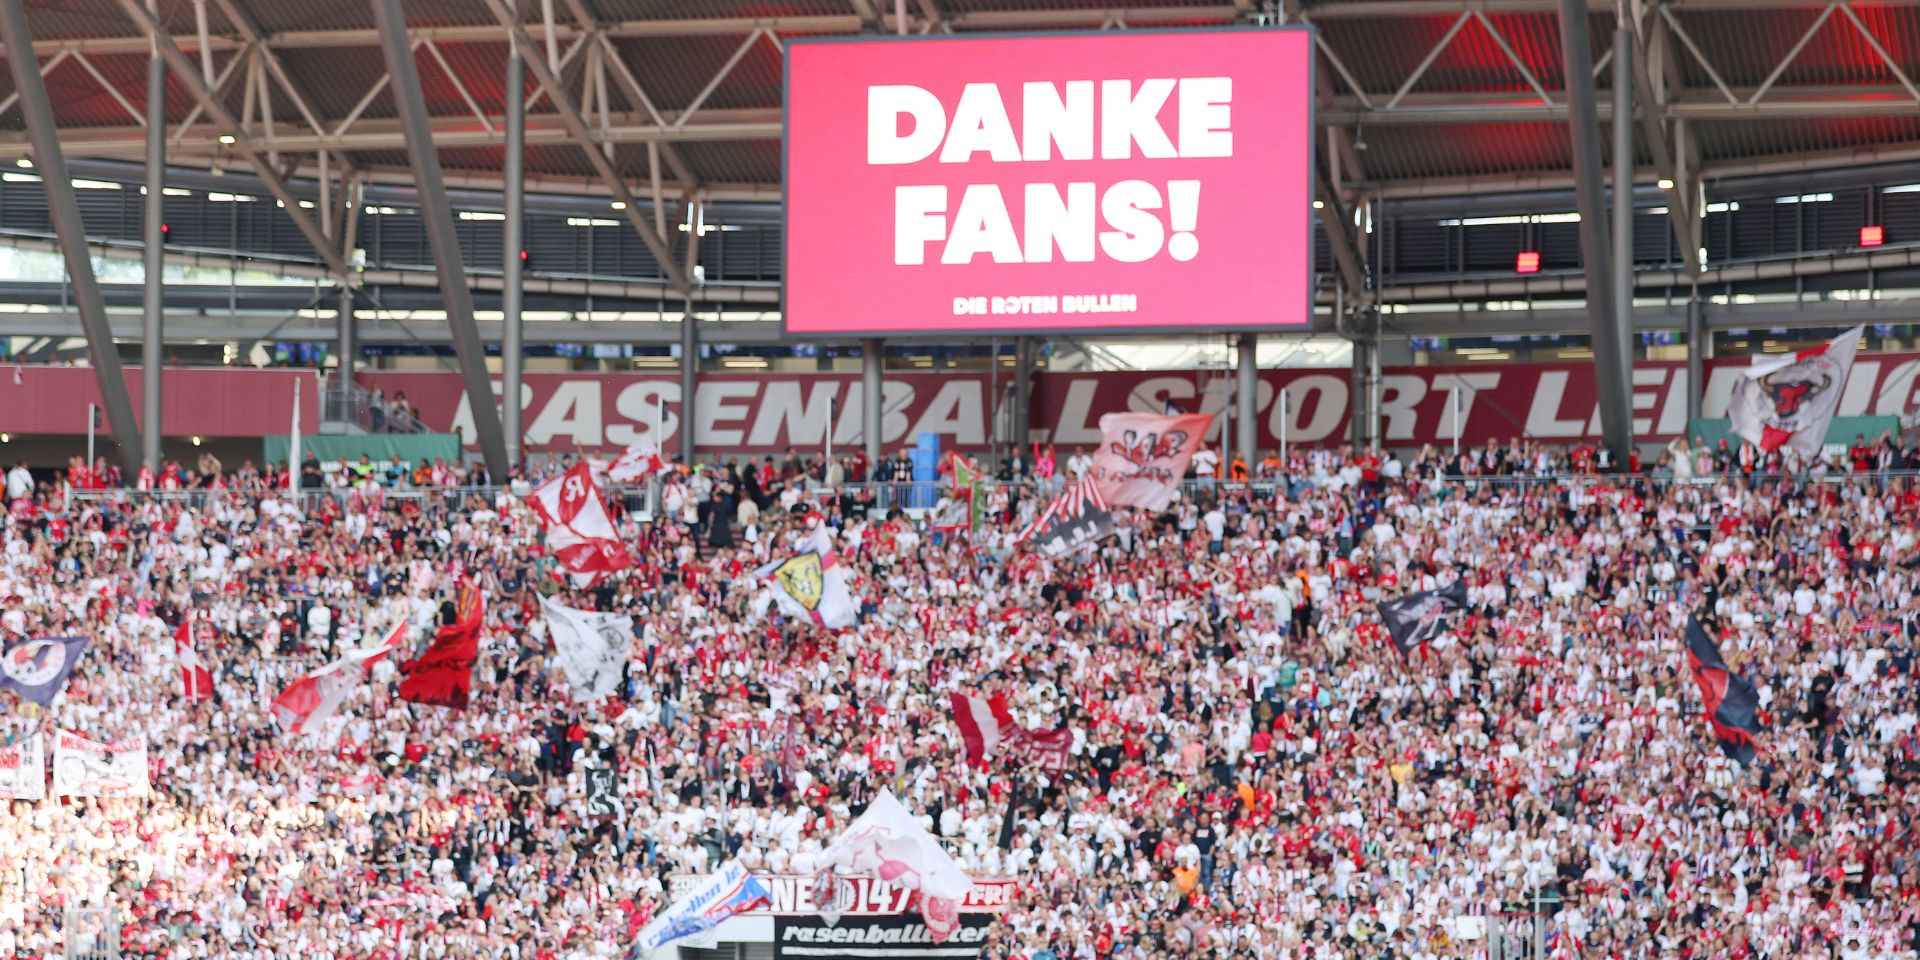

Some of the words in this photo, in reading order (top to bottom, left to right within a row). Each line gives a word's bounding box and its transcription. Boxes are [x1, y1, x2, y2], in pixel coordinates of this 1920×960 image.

[867, 77, 1233, 165] DANKE
[895, 179, 1201, 265] FANS!
[953, 296, 988, 316] DIE
[991, 295, 1058, 315] ROTEN
[1062, 293, 1137, 314] BULLEN
